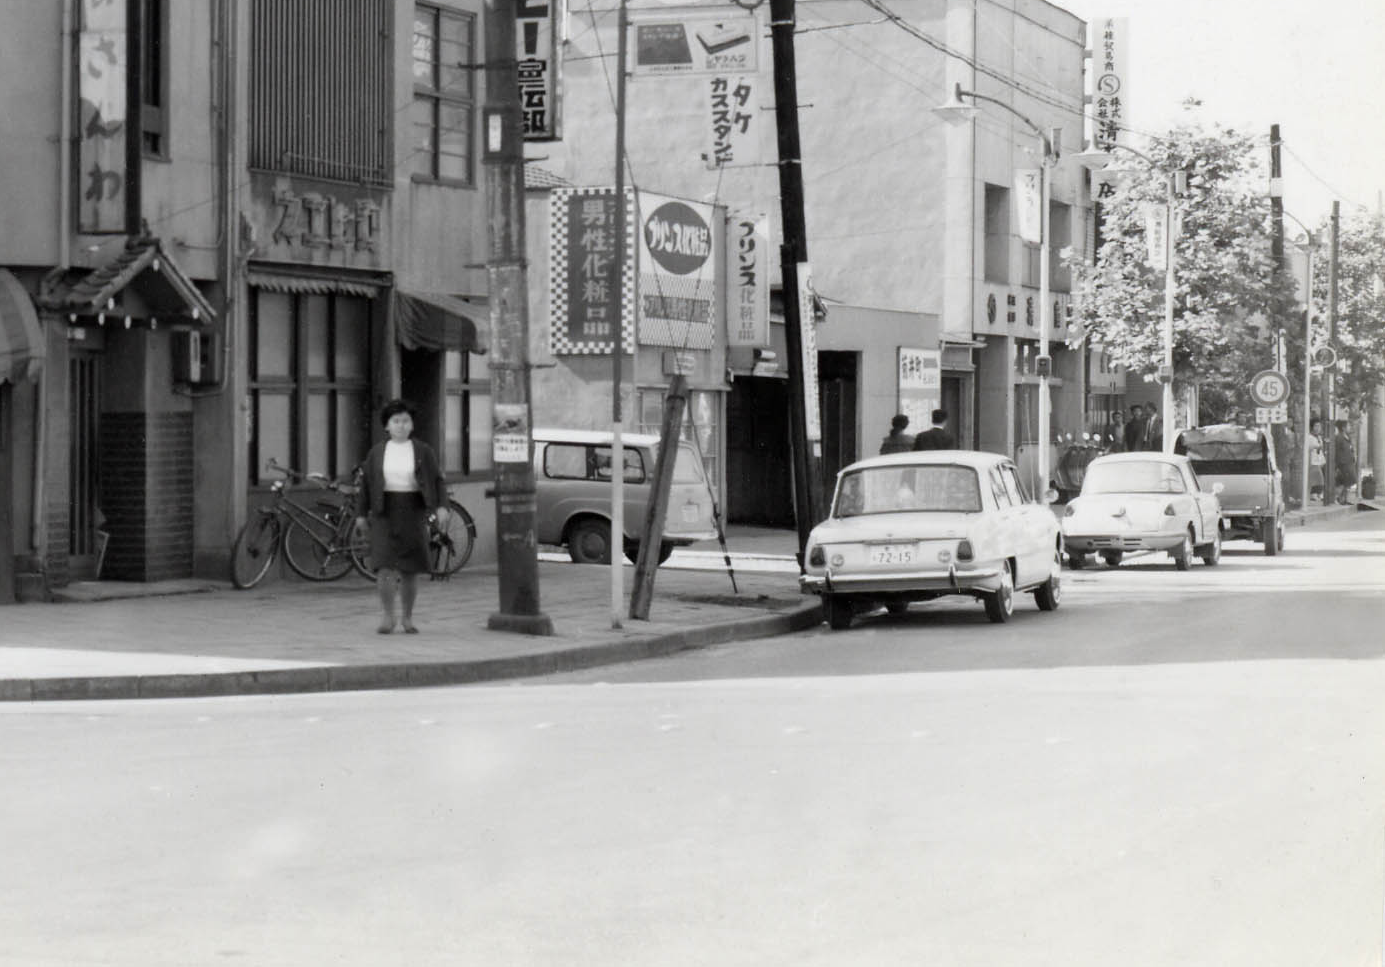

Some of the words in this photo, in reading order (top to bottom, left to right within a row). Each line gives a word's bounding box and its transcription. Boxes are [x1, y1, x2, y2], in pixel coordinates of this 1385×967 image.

[581, 199, 610, 336] 男性化粧品
[1261, 380, 1279, 397] 45
